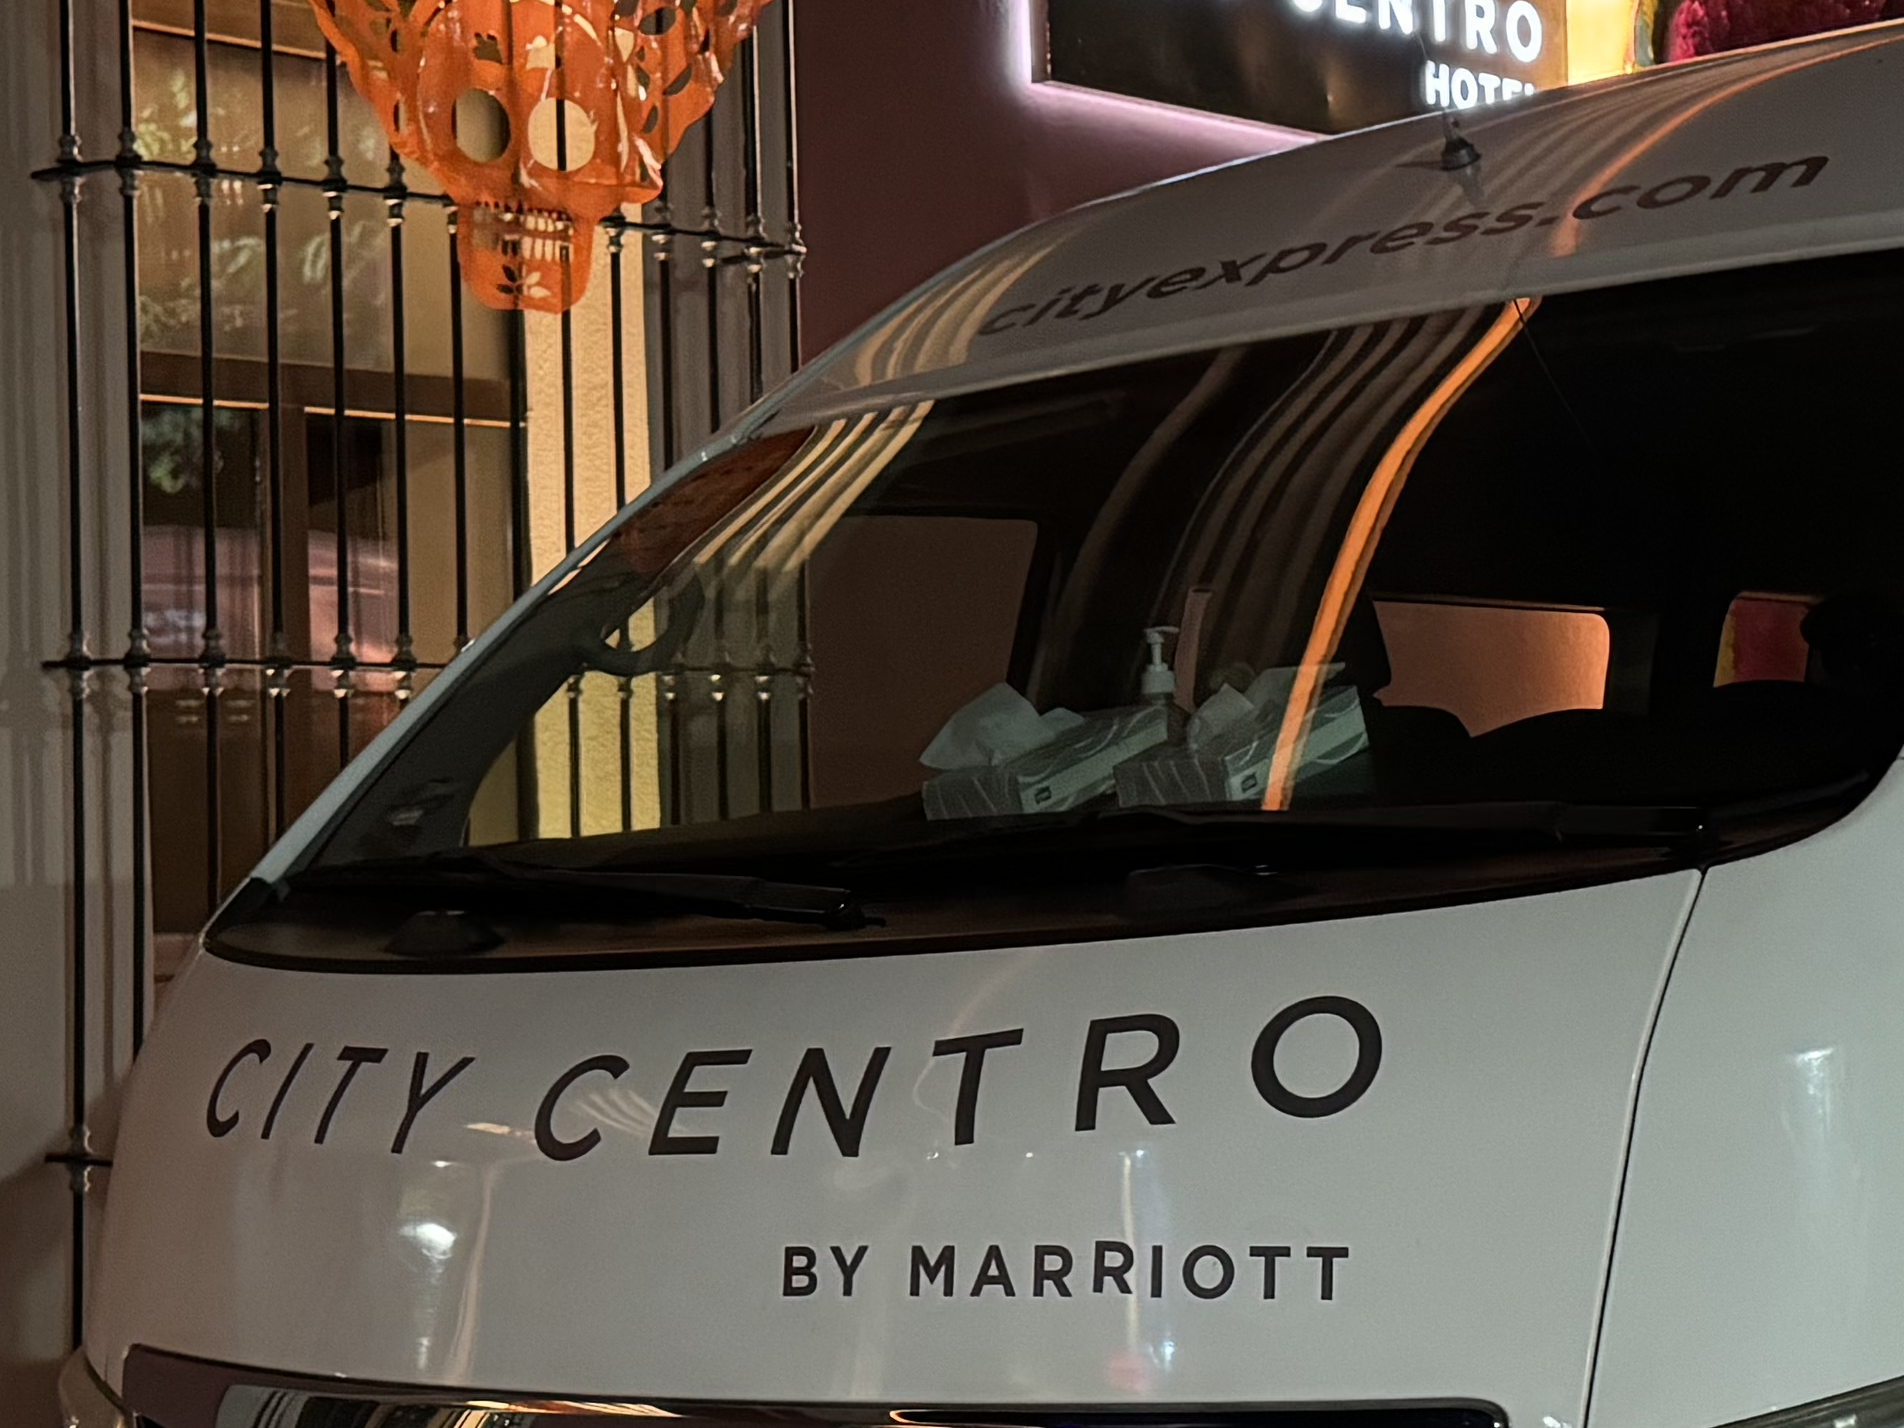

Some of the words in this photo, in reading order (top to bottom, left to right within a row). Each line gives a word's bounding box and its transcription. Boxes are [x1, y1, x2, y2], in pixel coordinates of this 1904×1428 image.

[978, 154, 1833, 337] cityexpress.com
[206, 1038, 475, 1155] CITY
[534, 995, 1384, 1162] CENTRO
[781, 1245, 869, 1298] BY
[909, 1240, 1350, 1301] MARRIOTT
